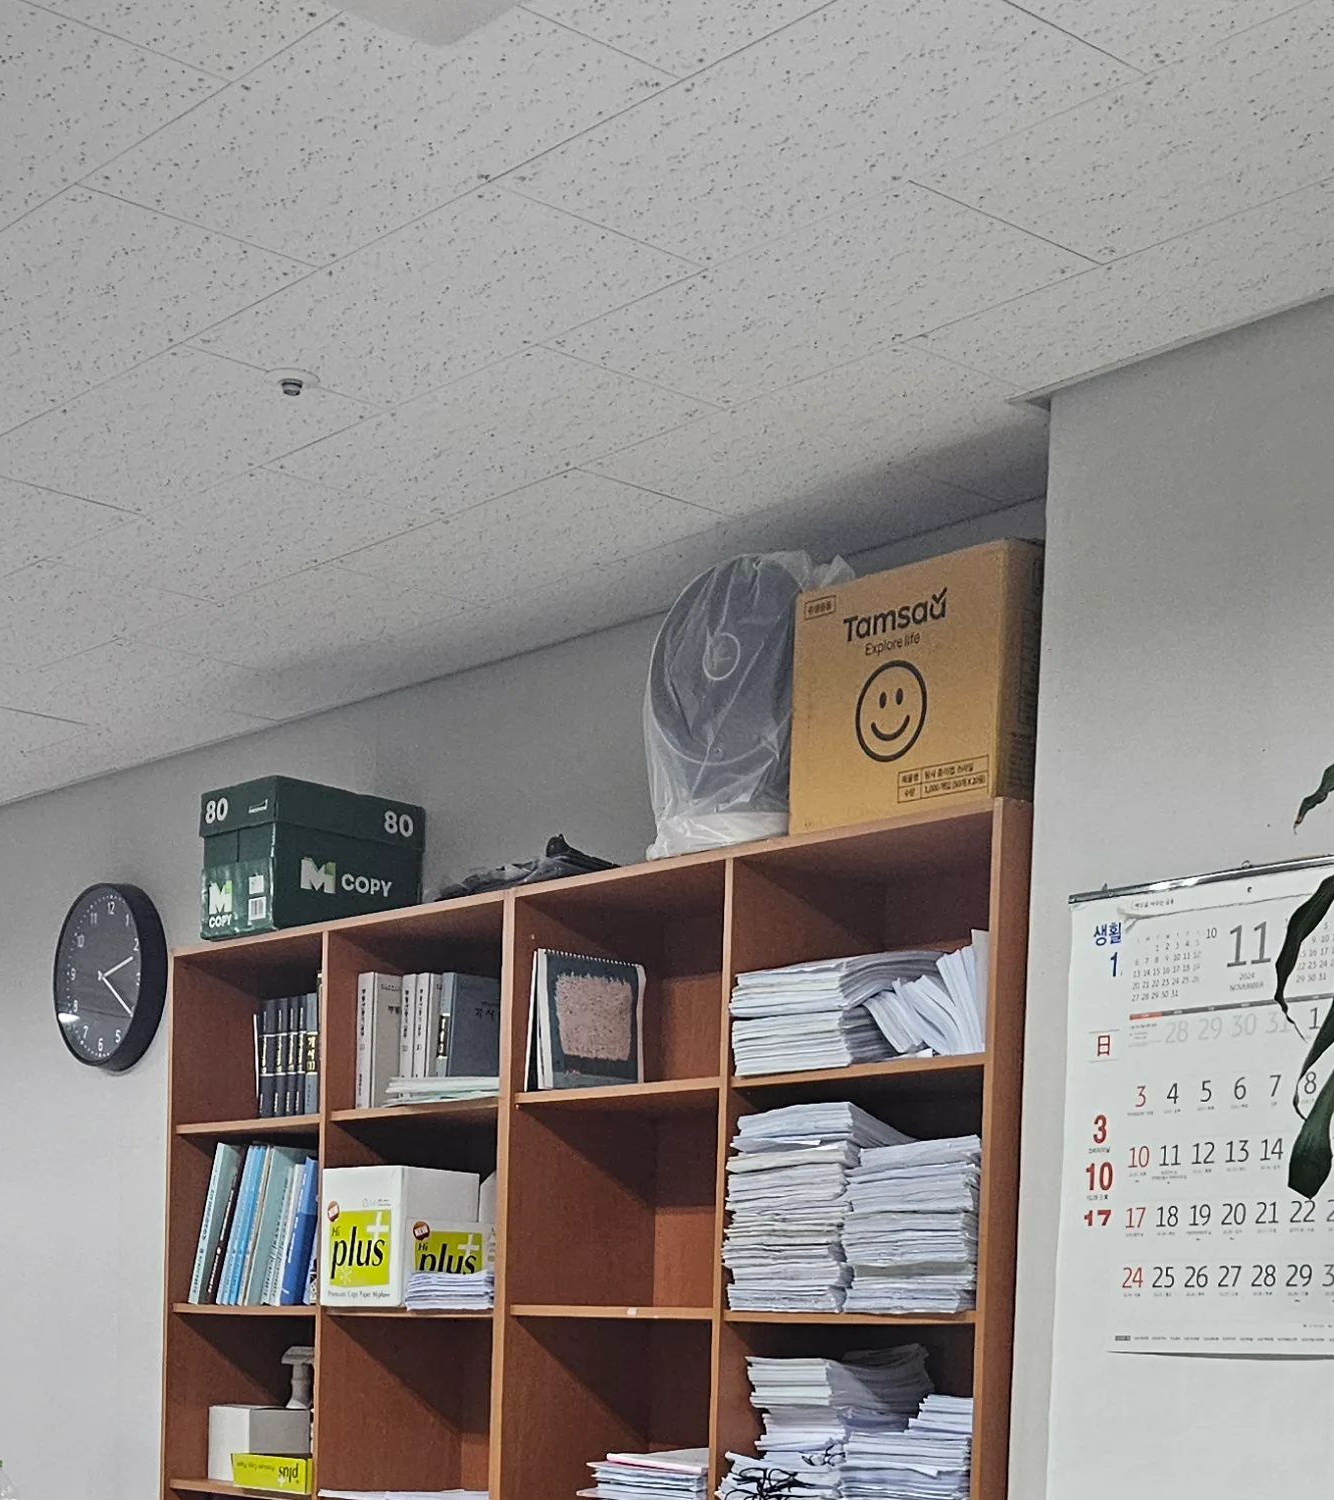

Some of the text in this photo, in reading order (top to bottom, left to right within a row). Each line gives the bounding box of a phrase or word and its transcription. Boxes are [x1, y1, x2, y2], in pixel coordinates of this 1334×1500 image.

[865, 632, 920, 656] Explore life
[205, 797, 228, 824] 80
[384, 811, 413, 837] 80
[300, 856, 393, 897] M COPY
[107, 902, 115, 915] 12
[208, 913, 232, 929] COPY
[1206, 927, 1218, 940] 10
[1226, 921, 1271, 968] 11
[1229, 981, 1264, 992] NOVEMBER
[1239, 971, 1256, 981] 2024
[115, 1030, 122, 1043] 5
[1165, 1020, 1189, 1044] 28
[1197, 1016, 1223, 1041] 29
[1230, 1013, 1257, 1037] 30
[1308, 1007, 1320, 1030] 1
[97, 1038, 104, 1051] 6
[1097, 1034, 1111, 1057] 日
[1135, 1085, 1147, 1108] 3
[1166, 1082, 1179, 1105] 4
[1199, 1079, 1212, 1103] 5
[1234, 1076, 1247, 1100] 6
[1269, 1074, 1282, 1098] 7
[1304, 1071, 1317, 1095] 8
[1093, 1114, 1108, 1144] 3
[1127, 1145, 1150, 1169] 10
[1159, 1144, 1181, 1167] 11
[1191, 1141, 1216, 1165] 12
[1225, 1139, 1250, 1163] 13
[1259, 1137, 1284, 1162] 14
[1086, 1161, 1114, 1191] 10
[1084, 1209, 1112, 1227] 17
[1125, 1206, 1147, 1229] 17
[1155, 1205, 1179, 1228] 18
[1188, 1203, 1212, 1227] 19
[1221, 1202, 1247, 1226] 20
[1255, 1201, 1279, 1225] 21
[1289, 1199, 1316, 1223] 22
[329, 1225, 385, 1279] plus
[1122, 1266, 1144, 1289] 24
[1152, 1266, 1175, 1289] 25
[1184, 1265, 1209, 1288] 26
[1217, 1265, 1242, 1288] 27
[1251, 1264, 1277, 1288] 28
[1285, 1264, 1313, 1288] 29
[278, 1462, 299, 1484] plus
